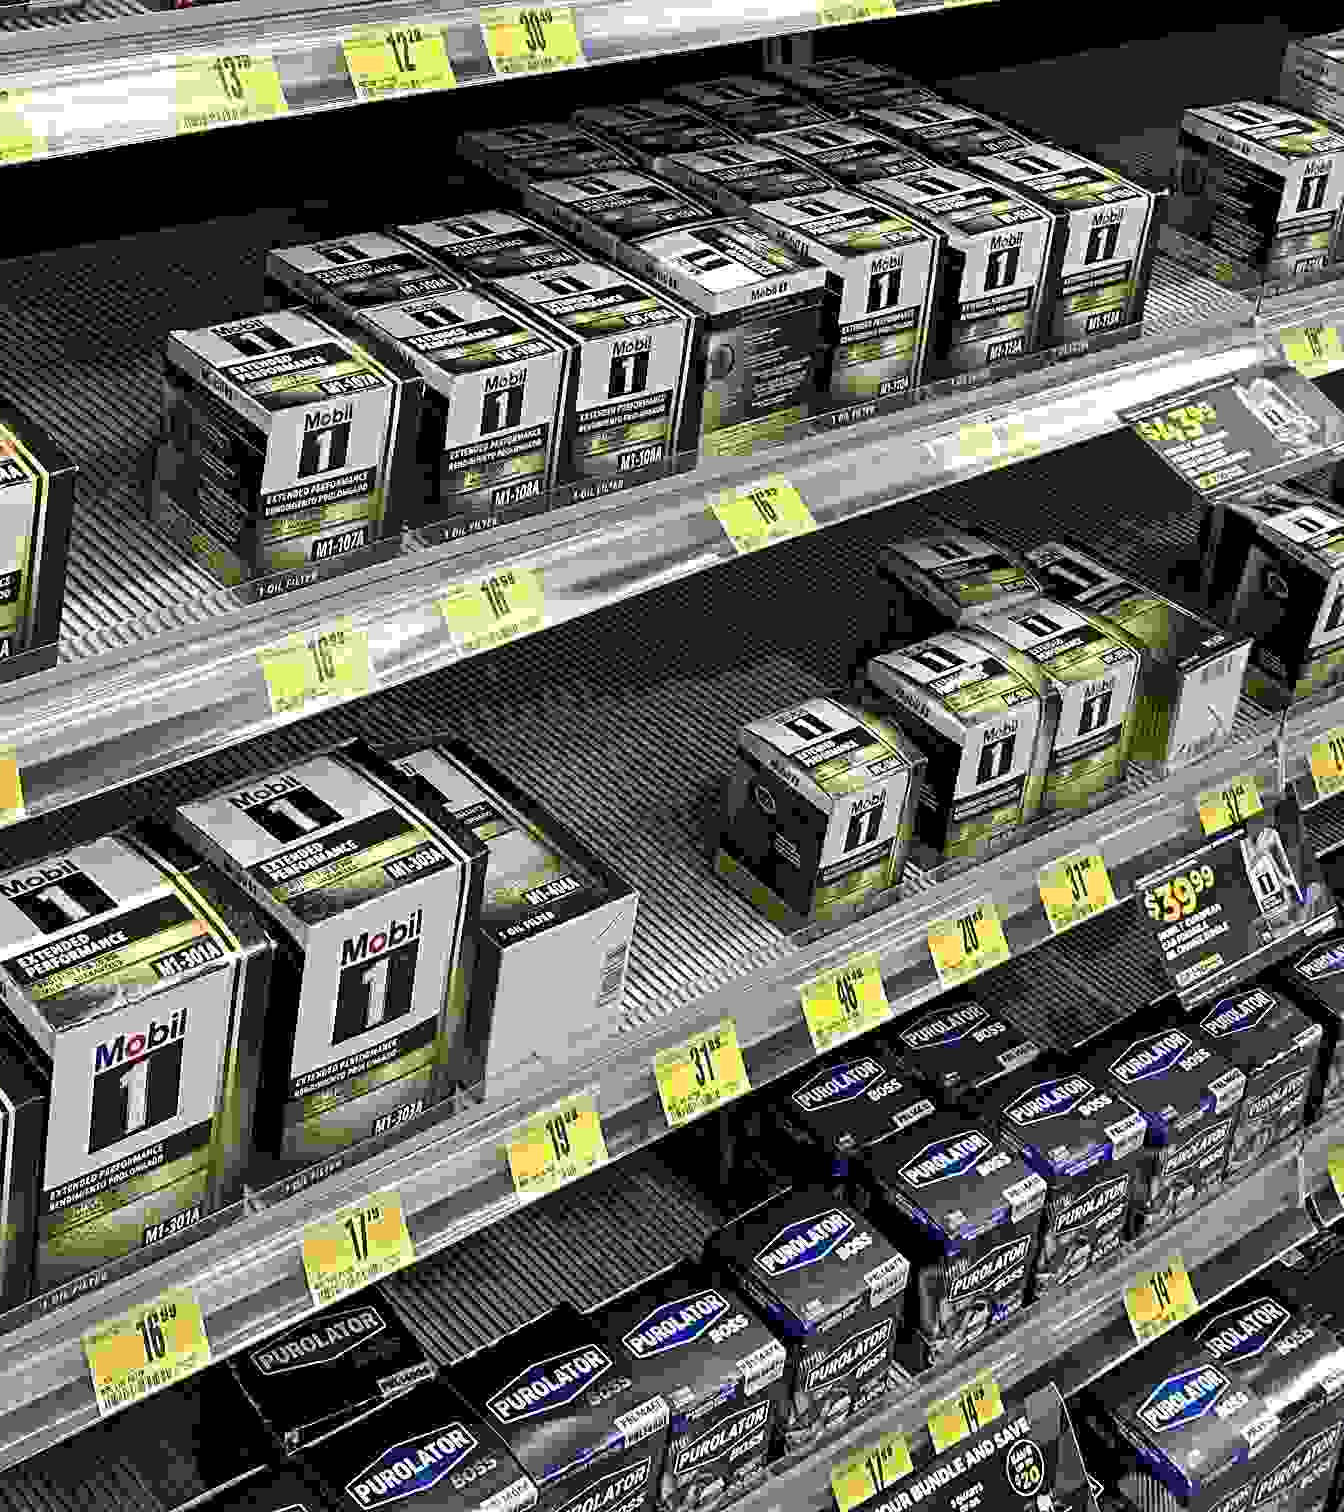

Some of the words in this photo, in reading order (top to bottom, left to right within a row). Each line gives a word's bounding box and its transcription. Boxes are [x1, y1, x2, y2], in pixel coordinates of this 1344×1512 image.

[871, 255, 905, 275] Mobil
[989, 232, 1024, 253] Mobil
[612, 334, 658, 358] Mobil
[320, 371, 381, 396] M1-107A
[485, 368, 528, 395] Mobil
[304, 404, 355, 433] Mobil
[494, 481, 542, 507] M1-108A
[315, 530, 366, 559] M1-107A
[528, 879, 581, 904] M1-404A
[341, 909, 423, 966] Mobil
[95, 1008, 188, 1068] Mobil
[1117, 1035, 1187, 1081] PUROLATOR
[799, 1059, 880, 1110] PUROLATOR
[1011, 1078, 1090, 1123] PUROLATOR
[904, 1134, 988, 1185] PUROLATOR
[145, 1210, 202, 1245] M1-301A
[762, 1214, 849, 1274] PUROLATOR
[259, 1313, 378, 1374] PUROLATOR
[630, 1296, 724, 1357] PUROLATOR
[495, 1350, 605, 1420] PUROLATOR
[1145, 1368, 1225, 1428] PUROLATOR
[354, 1432, 470, 1507] PUROLATOR
[908, 1460, 965, 1495] BUNDLE
[967, 1440, 996, 1466] AND
[994, 1418, 1031, 1448] SAVE
